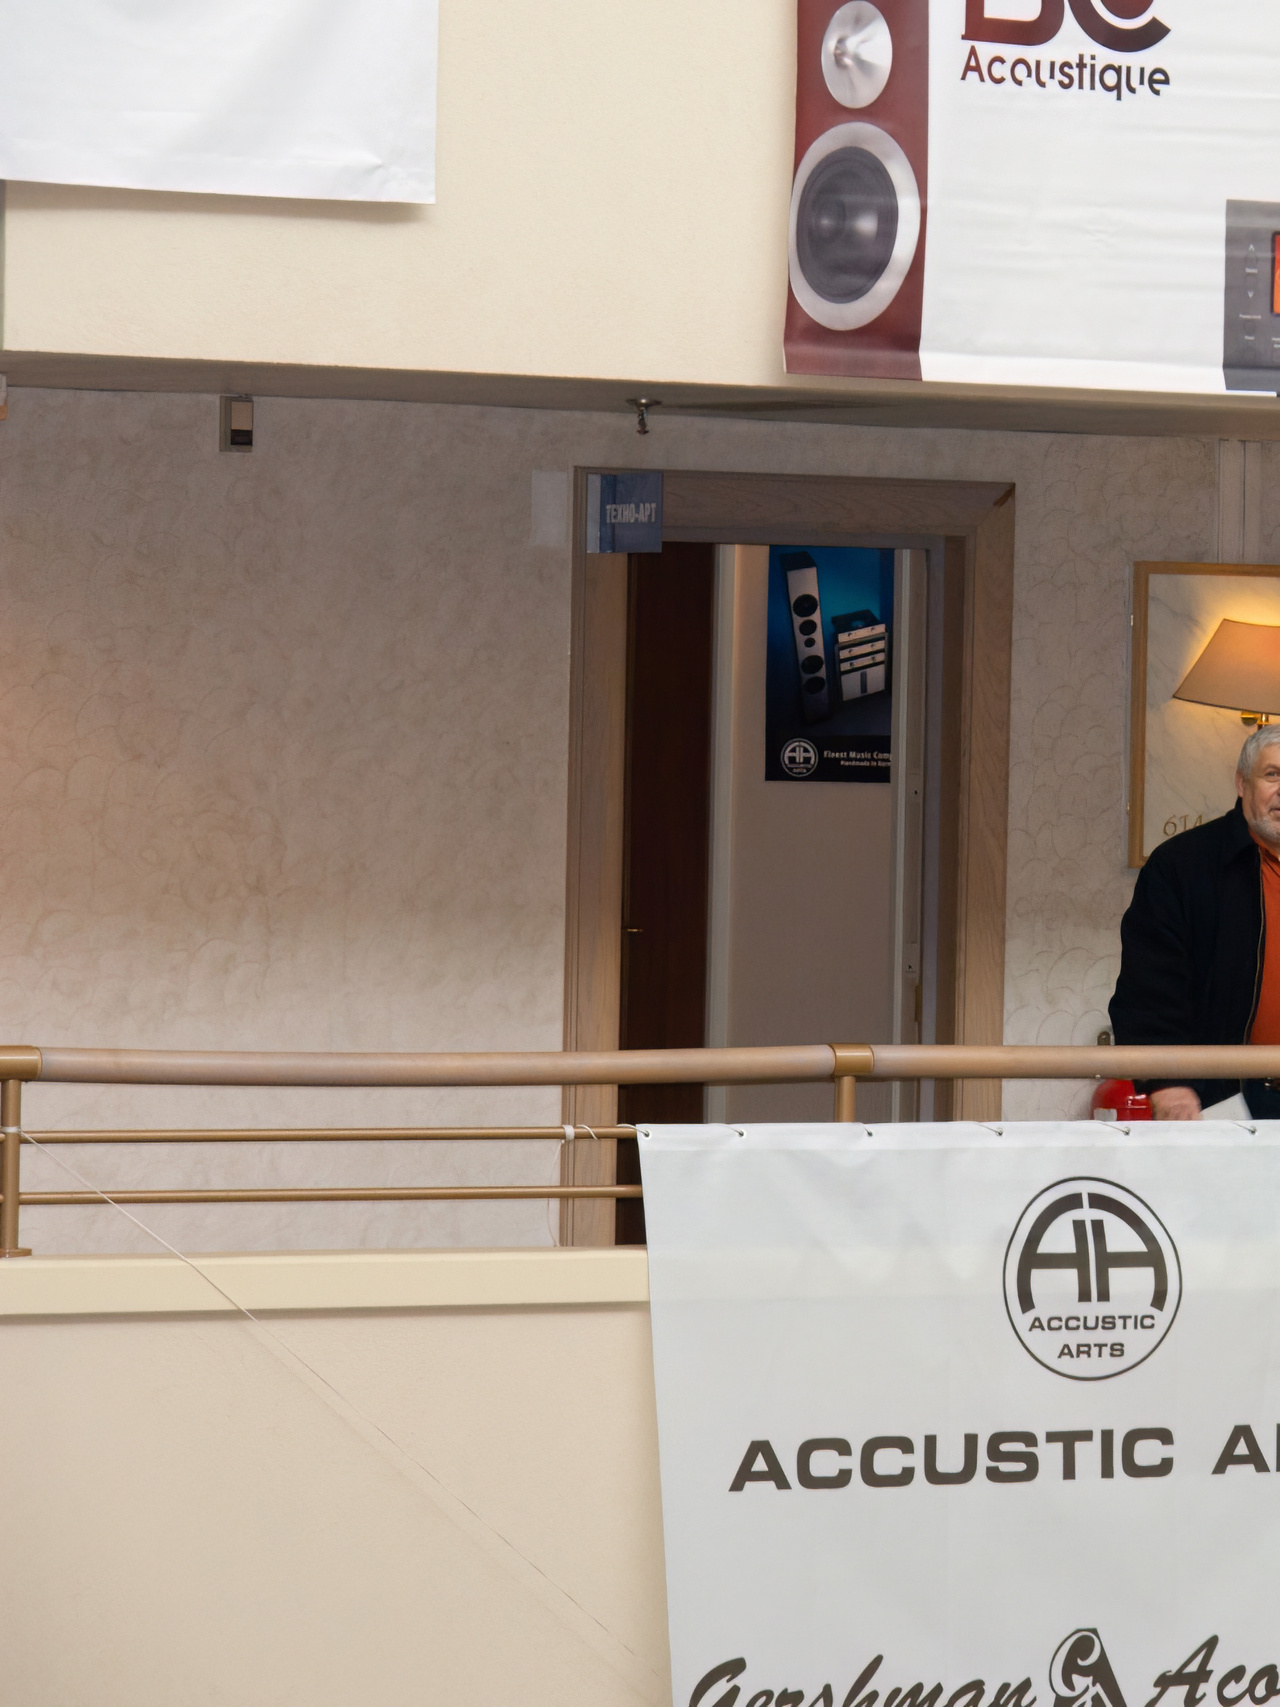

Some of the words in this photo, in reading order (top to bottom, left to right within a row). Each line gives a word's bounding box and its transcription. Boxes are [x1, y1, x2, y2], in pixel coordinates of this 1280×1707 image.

[960, 45, 1171, 101] Acoustique
[606, 502, 657, 523] ТЕХНО-АРТ
[1028, 1315, 1155, 1332] ACCUSTIC
[1057, 1342, 1125, 1359] ARTS
[728, 1427, 1175, 1493] ACCUSTIC
